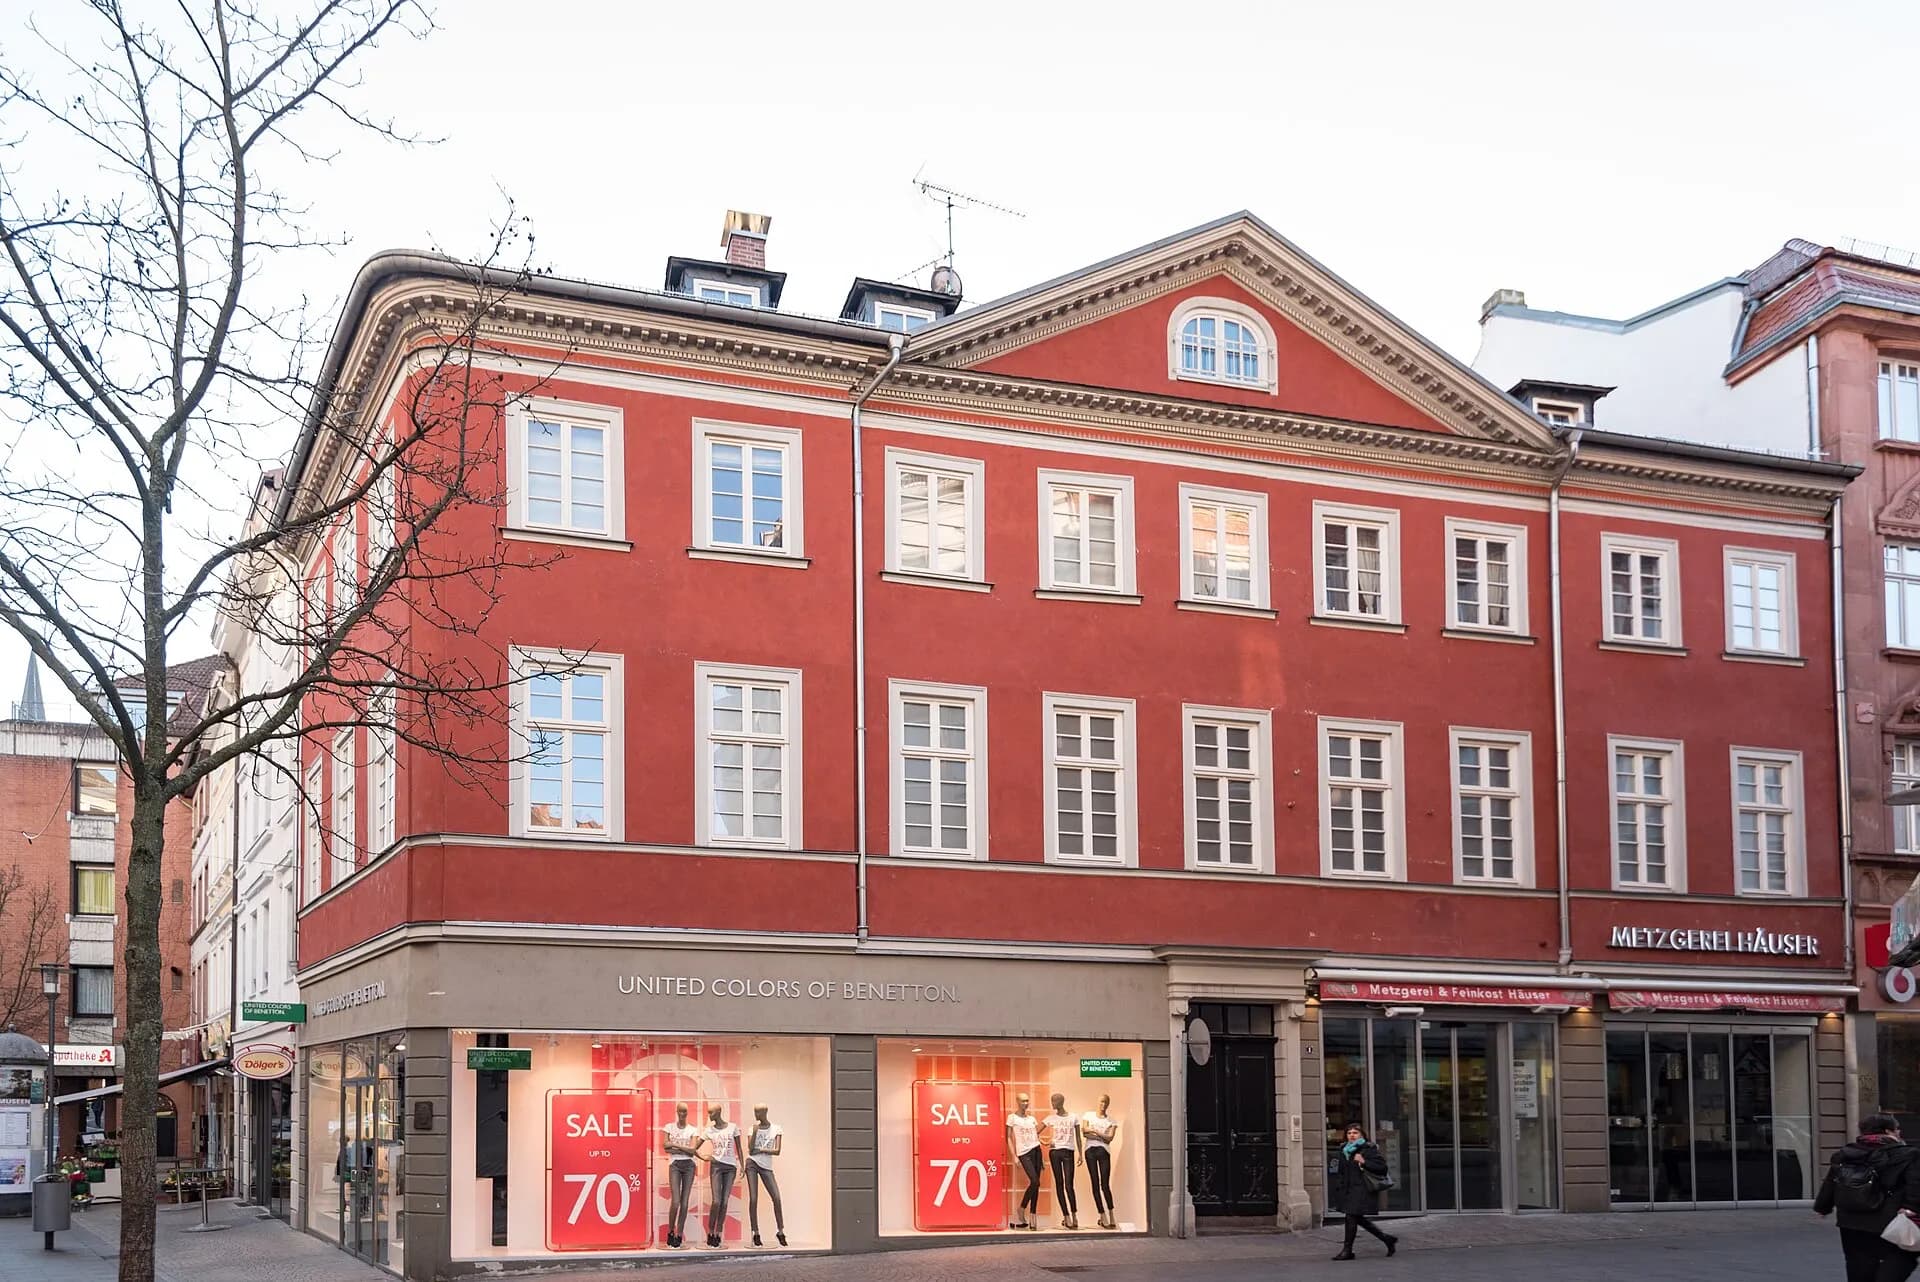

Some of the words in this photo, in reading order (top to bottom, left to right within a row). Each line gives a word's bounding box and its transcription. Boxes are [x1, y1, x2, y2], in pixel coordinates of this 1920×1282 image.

[1611, 926, 1733, 951] METZGEREI
[1738, 927, 1820, 955] HÄUSER
[618, 975, 705, 996] UNITED
[711, 978, 801, 998] COLORS
[808, 981, 836, 999] OF
[1369, 984, 1433, 998] Metzgerei
[1438, 986, 1448, 997] &
[1451, 986, 1503, 999] Feinkost
[1508, 989, 1551, 1000] Häuser
[1651, 992, 1709, 1005] Metzgerei
[1724, 994, 1771, 1005] Feinkost
[243, 1060, 285, 1071] Dölger's
[931, 1103, 990, 1126] SALE
[566, 1113, 634, 1138] SALE
[952, 1137, 961, 1145] UP
[961, 1137, 971, 1145] TO
[588, 1150, 600, 1158] UP
[600, 1150, 611, 1158] TO
